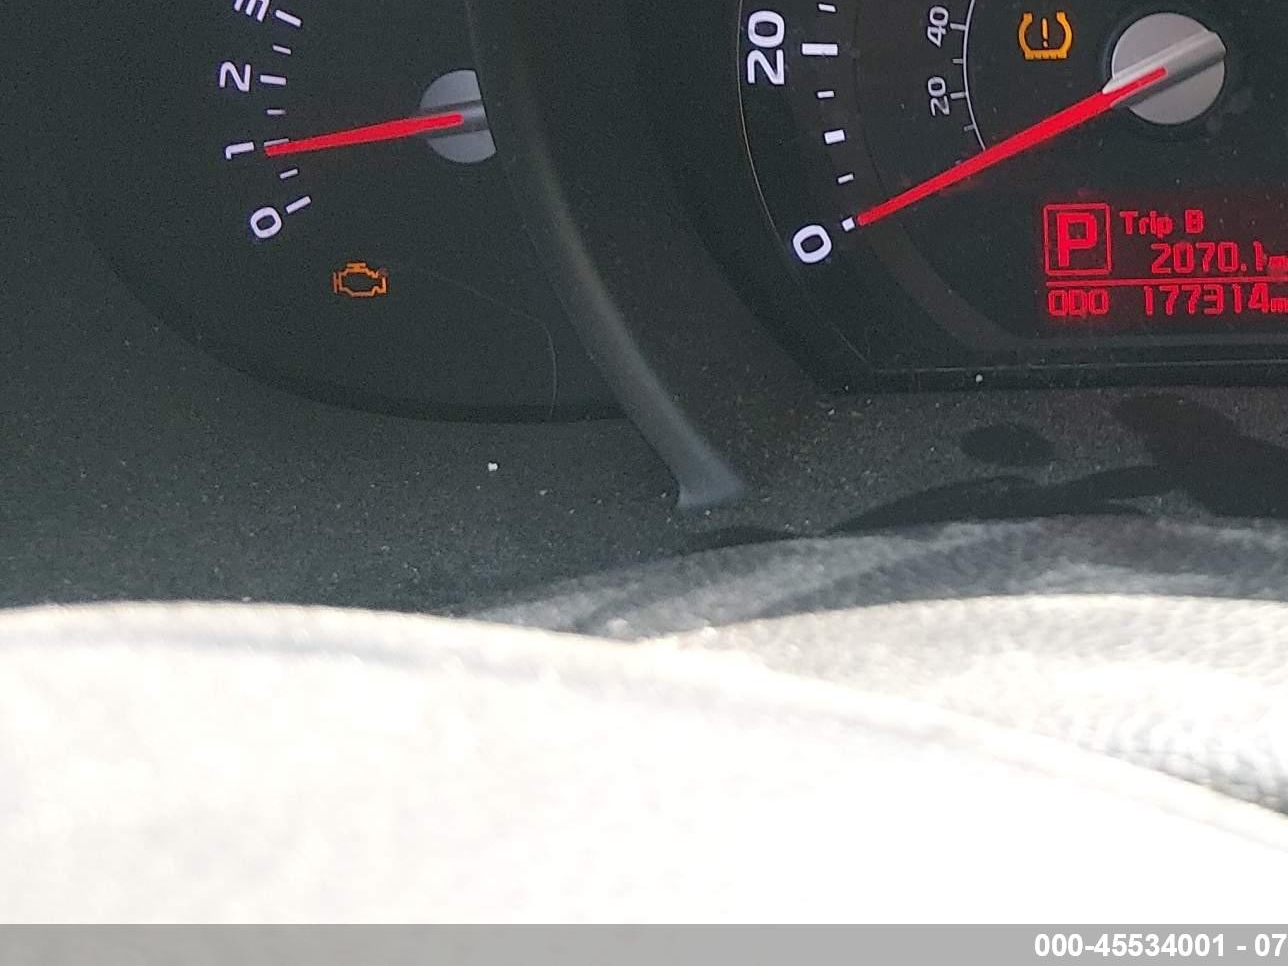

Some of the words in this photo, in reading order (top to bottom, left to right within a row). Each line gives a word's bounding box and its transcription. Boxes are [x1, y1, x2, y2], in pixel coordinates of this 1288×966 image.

[926, 5, 951, 48] 40
[747, 10, 786, 85] 20
[218, 60, 252, 93] 2
[927, 75, 952, 117] 20
[224, 140, 256, 161] 1
[249, 206, 283, 240] 0
[1055, 211, 1099, 268] P
[1119, 210, 1174, 238] Trip
[1184, 208, 1206, 234] B
[791, 223, 832, 263] 0
[1047, 288, 1110, 317] ODO
[1143, 283, 1269, 316] 177314
